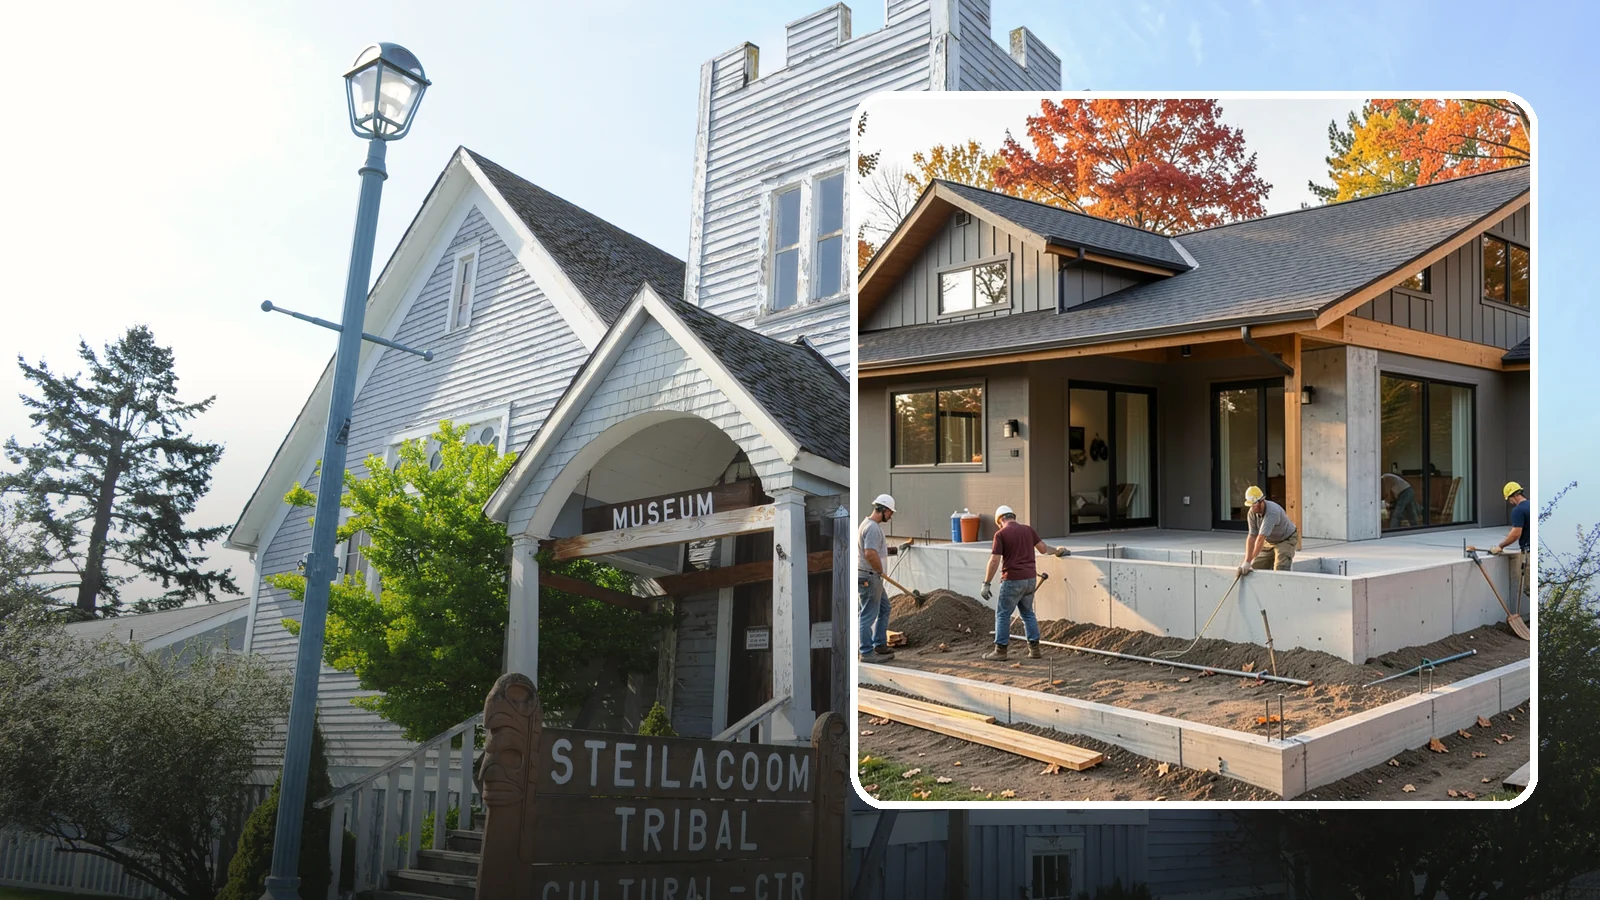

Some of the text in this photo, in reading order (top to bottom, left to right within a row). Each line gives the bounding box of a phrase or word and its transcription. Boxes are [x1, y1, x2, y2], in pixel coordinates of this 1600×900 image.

[613, 491, 714, 531] MUSEUM
[550, 738, 810, 793] STEILACOOM
[614, 806, 758, 853] TRIBAL
